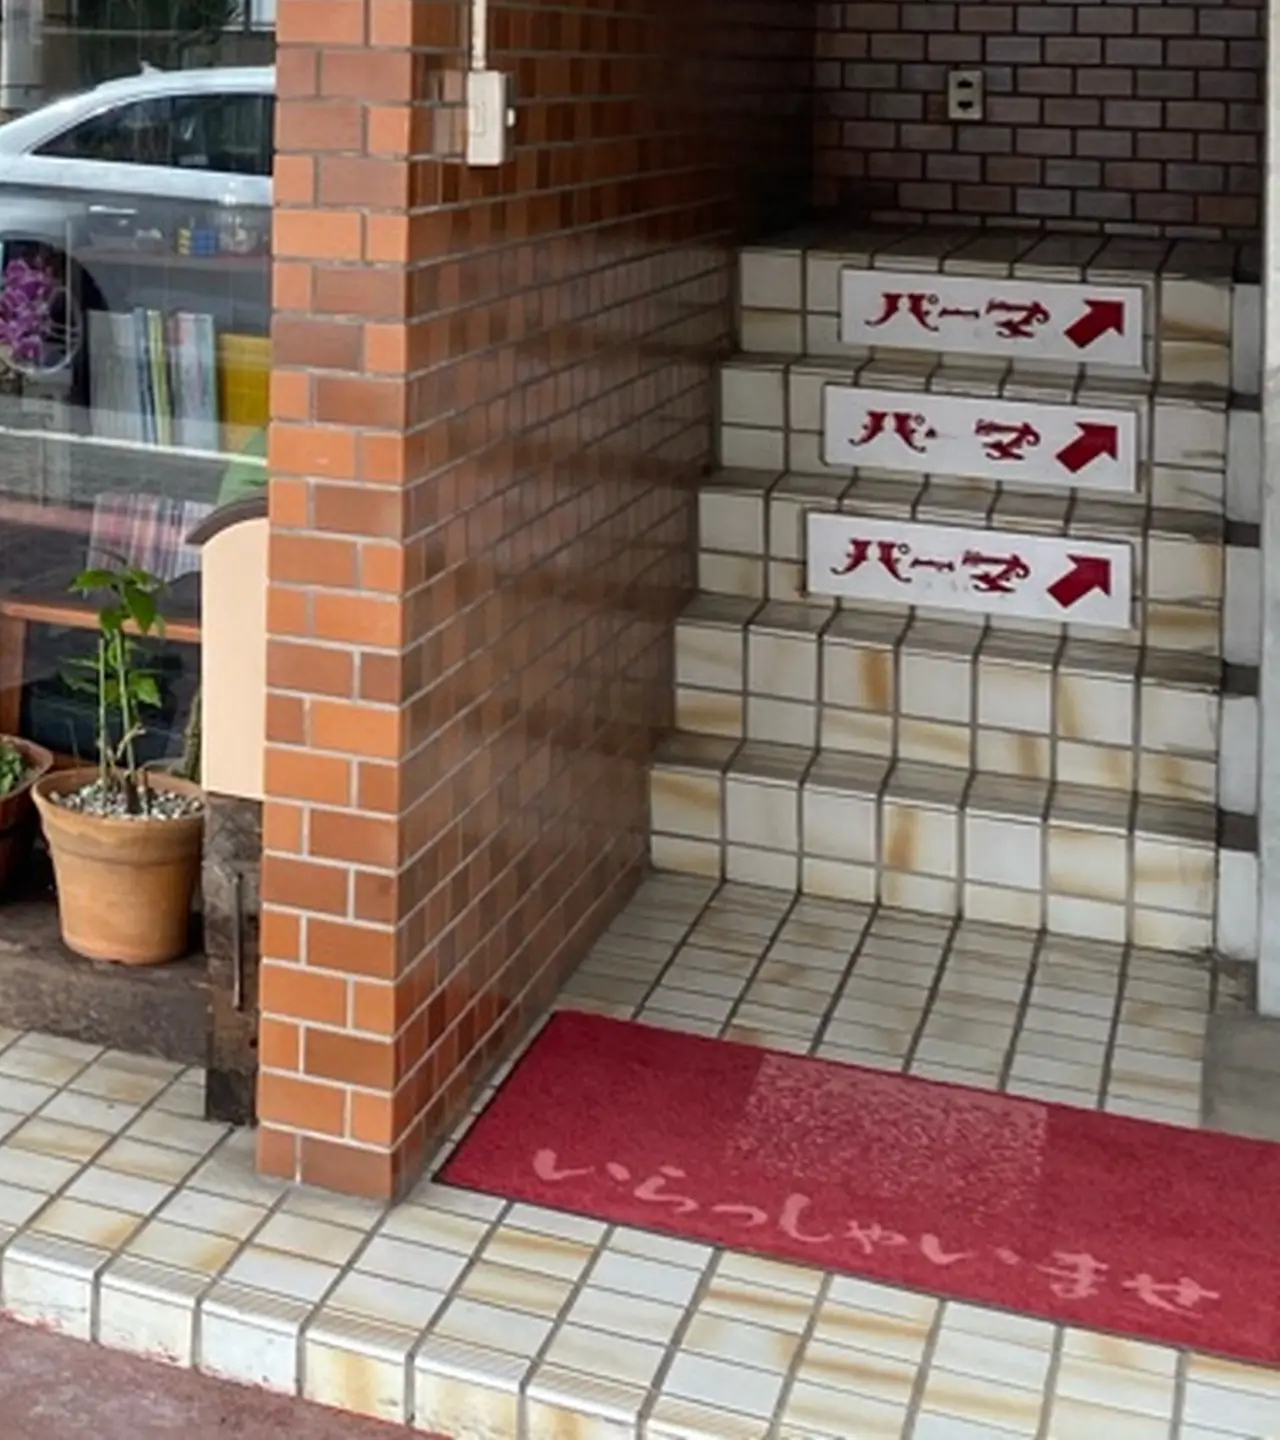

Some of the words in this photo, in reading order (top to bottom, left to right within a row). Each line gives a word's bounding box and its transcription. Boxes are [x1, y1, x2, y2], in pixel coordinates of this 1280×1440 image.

[864, 292, 1050, 340] パーマ
[830, 537, 1031, 593] パーマ
[533, 1147, 1219, 1316] いらっしゃいませ
